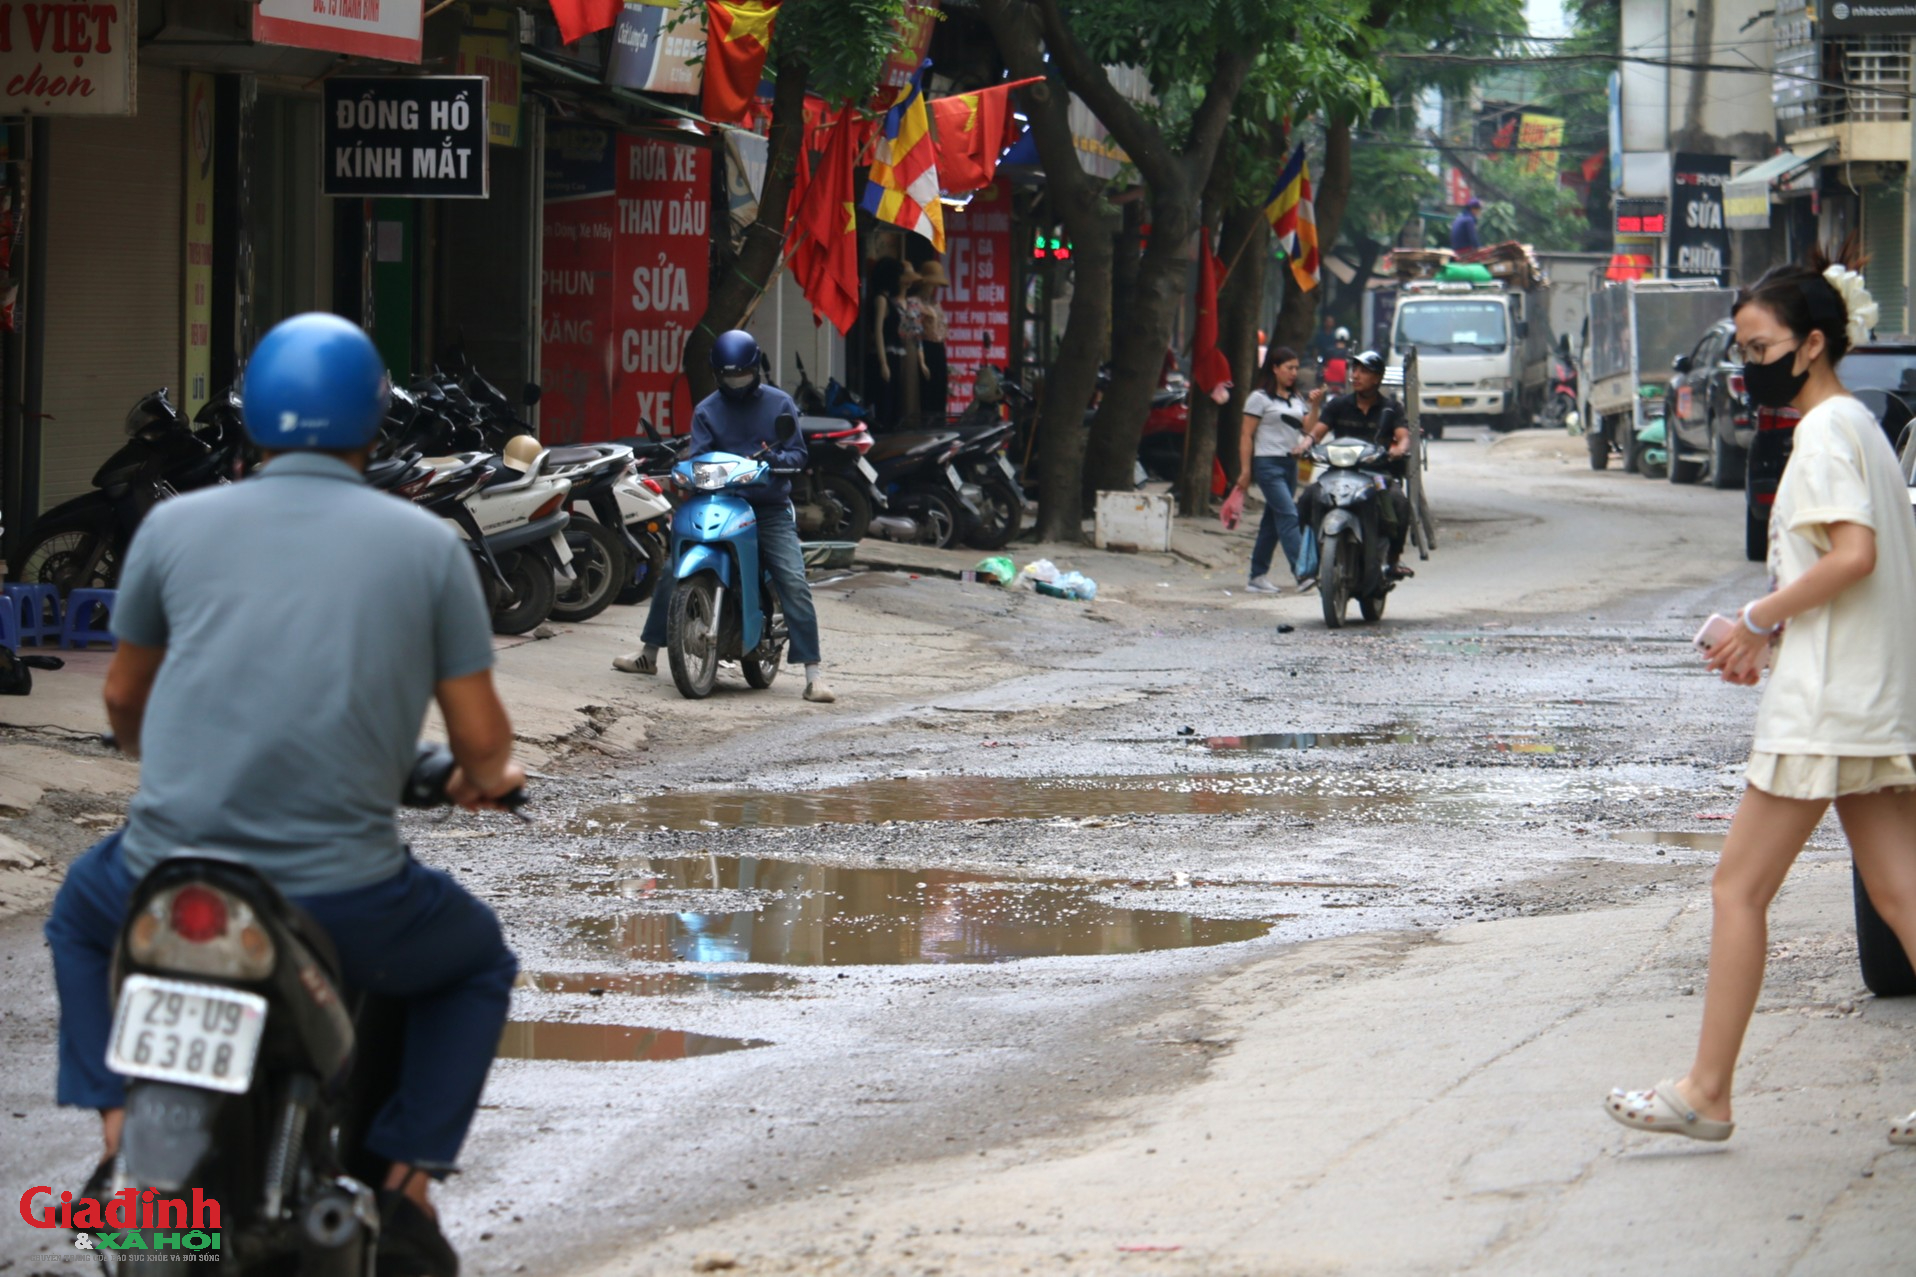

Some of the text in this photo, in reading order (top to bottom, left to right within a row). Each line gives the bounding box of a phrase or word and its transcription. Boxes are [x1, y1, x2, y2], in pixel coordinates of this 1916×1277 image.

[23, 0, 117, 68] VIỆT
[6, 62, 95, 106] chọn
[336, 89, 470, 131] ĐỒNG HỒ
[335, 135, 471, 179] KÍNH MẮT
[672, 145, 697, 182] XE
[618, 187, 706, 236] THAY DẦU
[1686, 191, 1722, 230] SỬA
[632, 252, 690, 311] SỬA
[635, 391, 671, 435] XE
[133, 1030, 234, 1079] 6388
